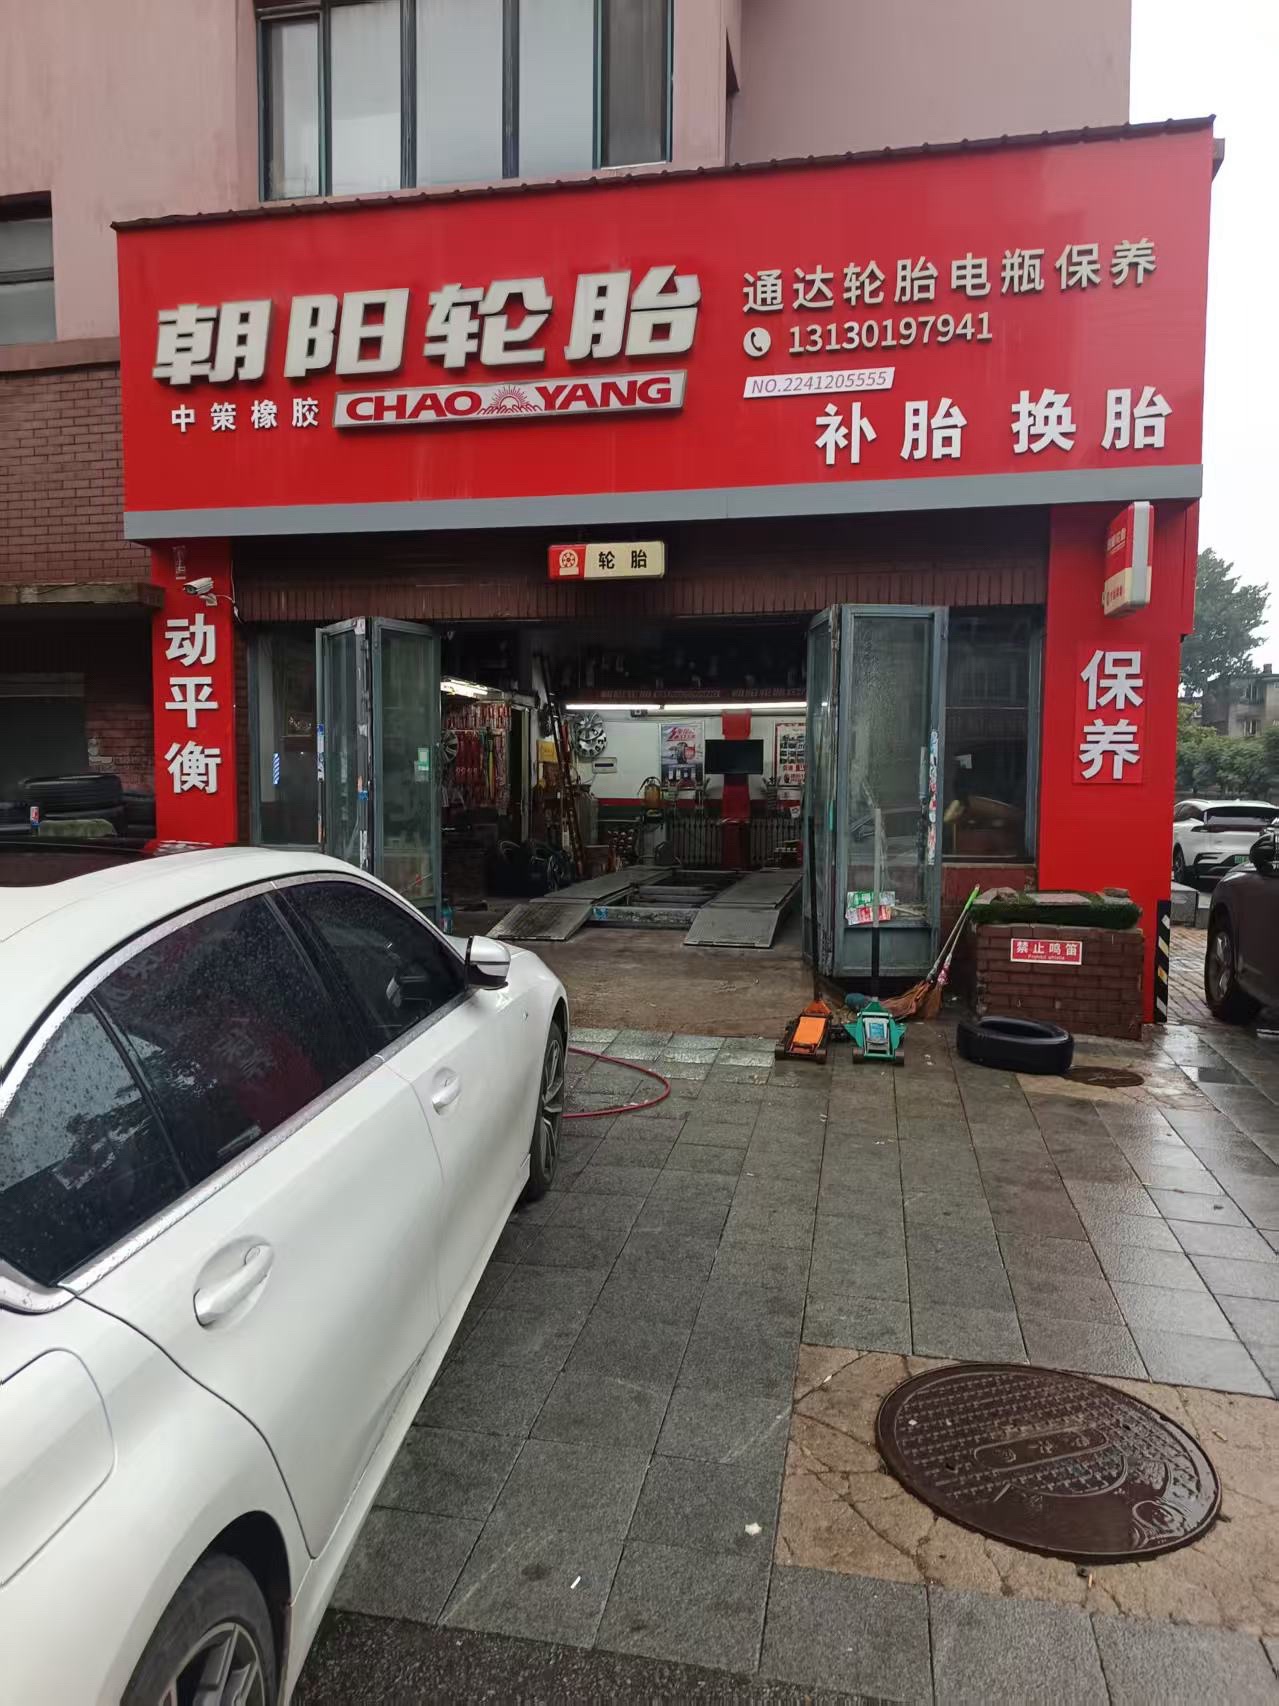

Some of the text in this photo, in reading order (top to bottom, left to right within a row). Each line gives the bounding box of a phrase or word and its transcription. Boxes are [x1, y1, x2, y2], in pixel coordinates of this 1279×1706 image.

[742, 236, 1158, 313] 通达轮胎电瓶保养
[152, 264, 701, 386] 朝阳轮胎
[788, 310, 993, 354] 13130197941
[345, 376, 671, 422] CHAO YANG
[751, 371, 888, 394] NO.2241205555
[171, 397, 320, 433] 中策橡胶
[815, 385, 1173, 465] 补胎 换胎
[598, 549, 648, 570] 轮胎
[164, 612, 222, 794] 动平衡
[1079, 649, 1144, 780] 保养
[1016, 941, 1078, 956] 禁止鸣笛
